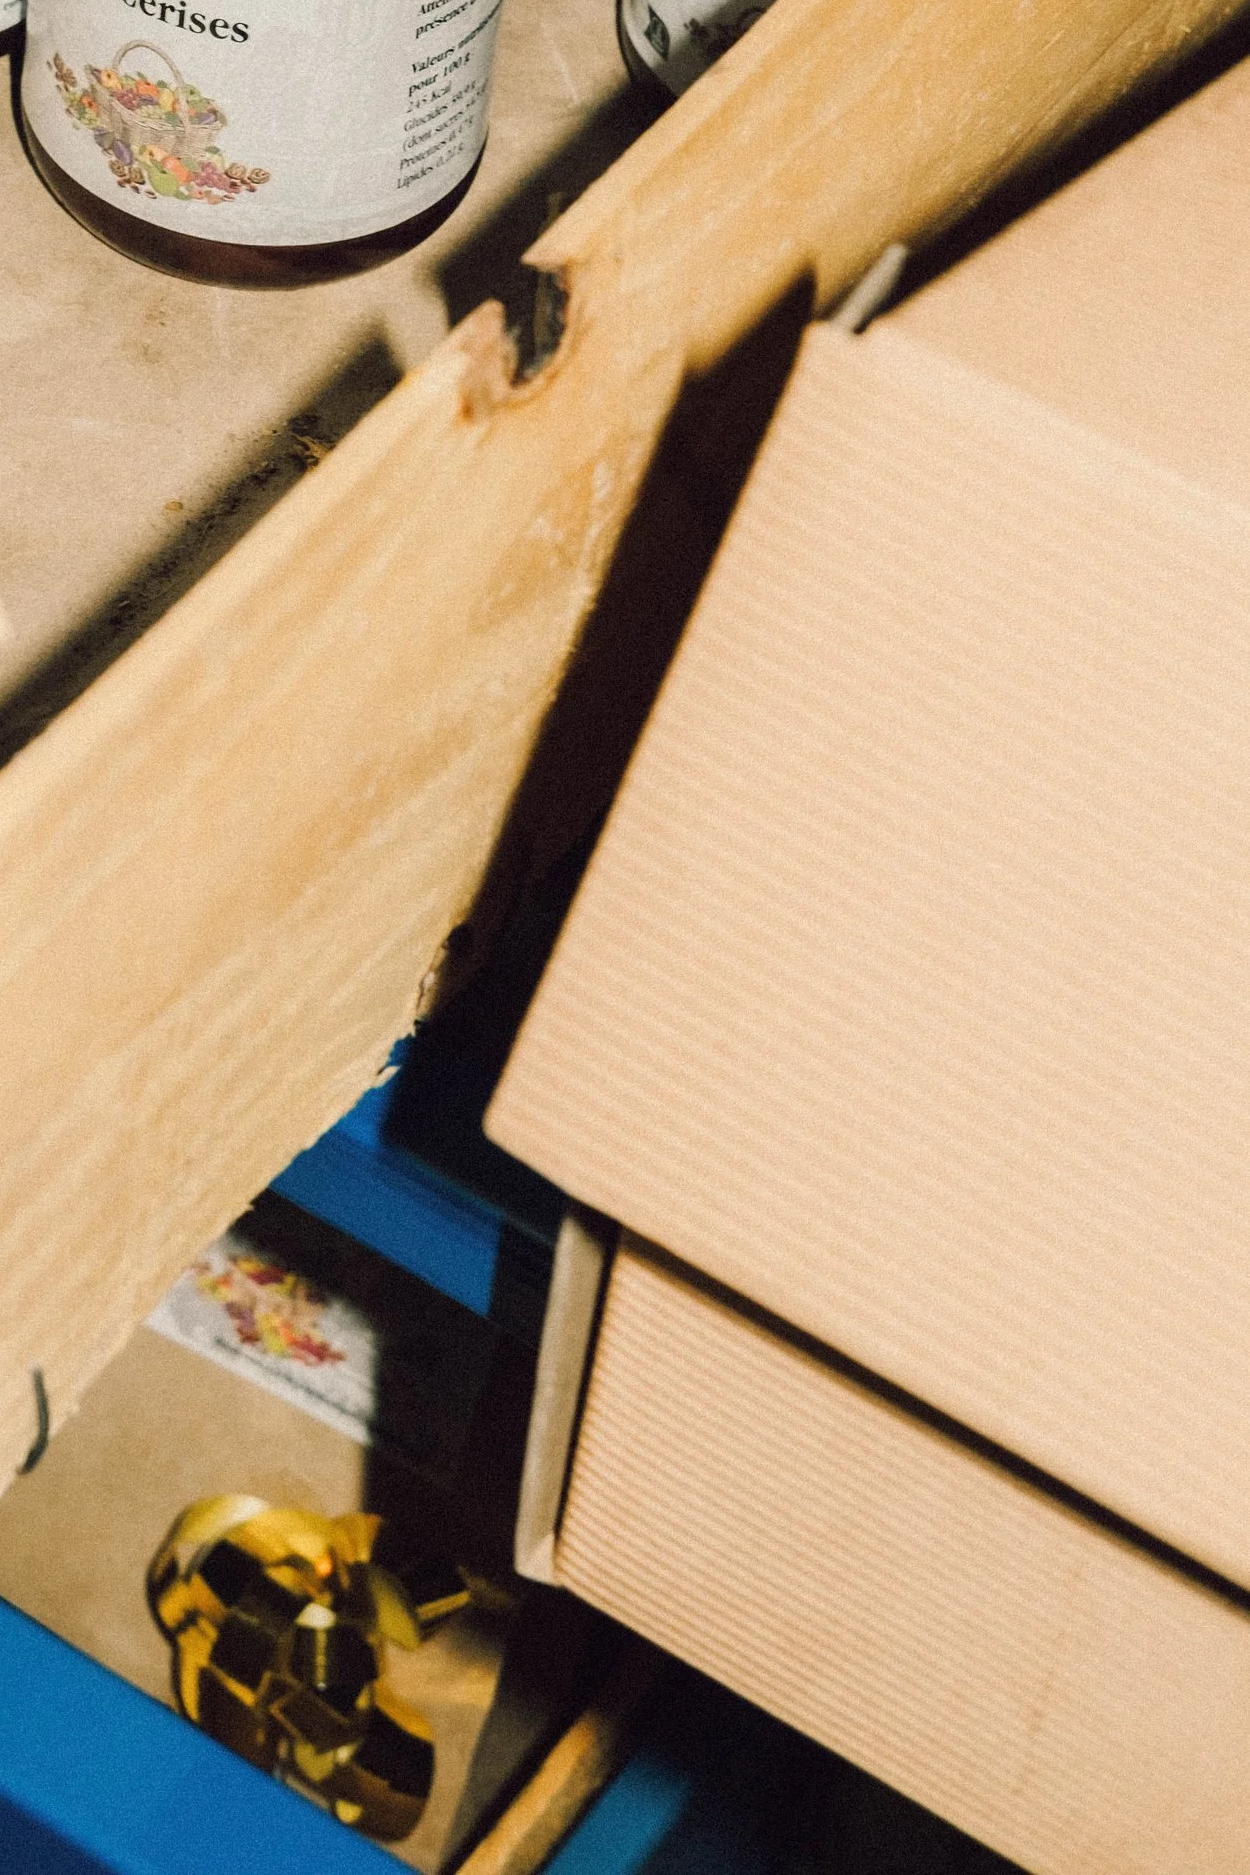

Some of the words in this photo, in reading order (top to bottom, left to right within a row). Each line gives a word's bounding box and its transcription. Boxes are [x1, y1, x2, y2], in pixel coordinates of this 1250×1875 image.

[415, 1, 469, 39] présence
[408, 73, 439, 98] pour
[443, 56, 463, 77] 100
[412, 45, 455, 73] Valeurs
